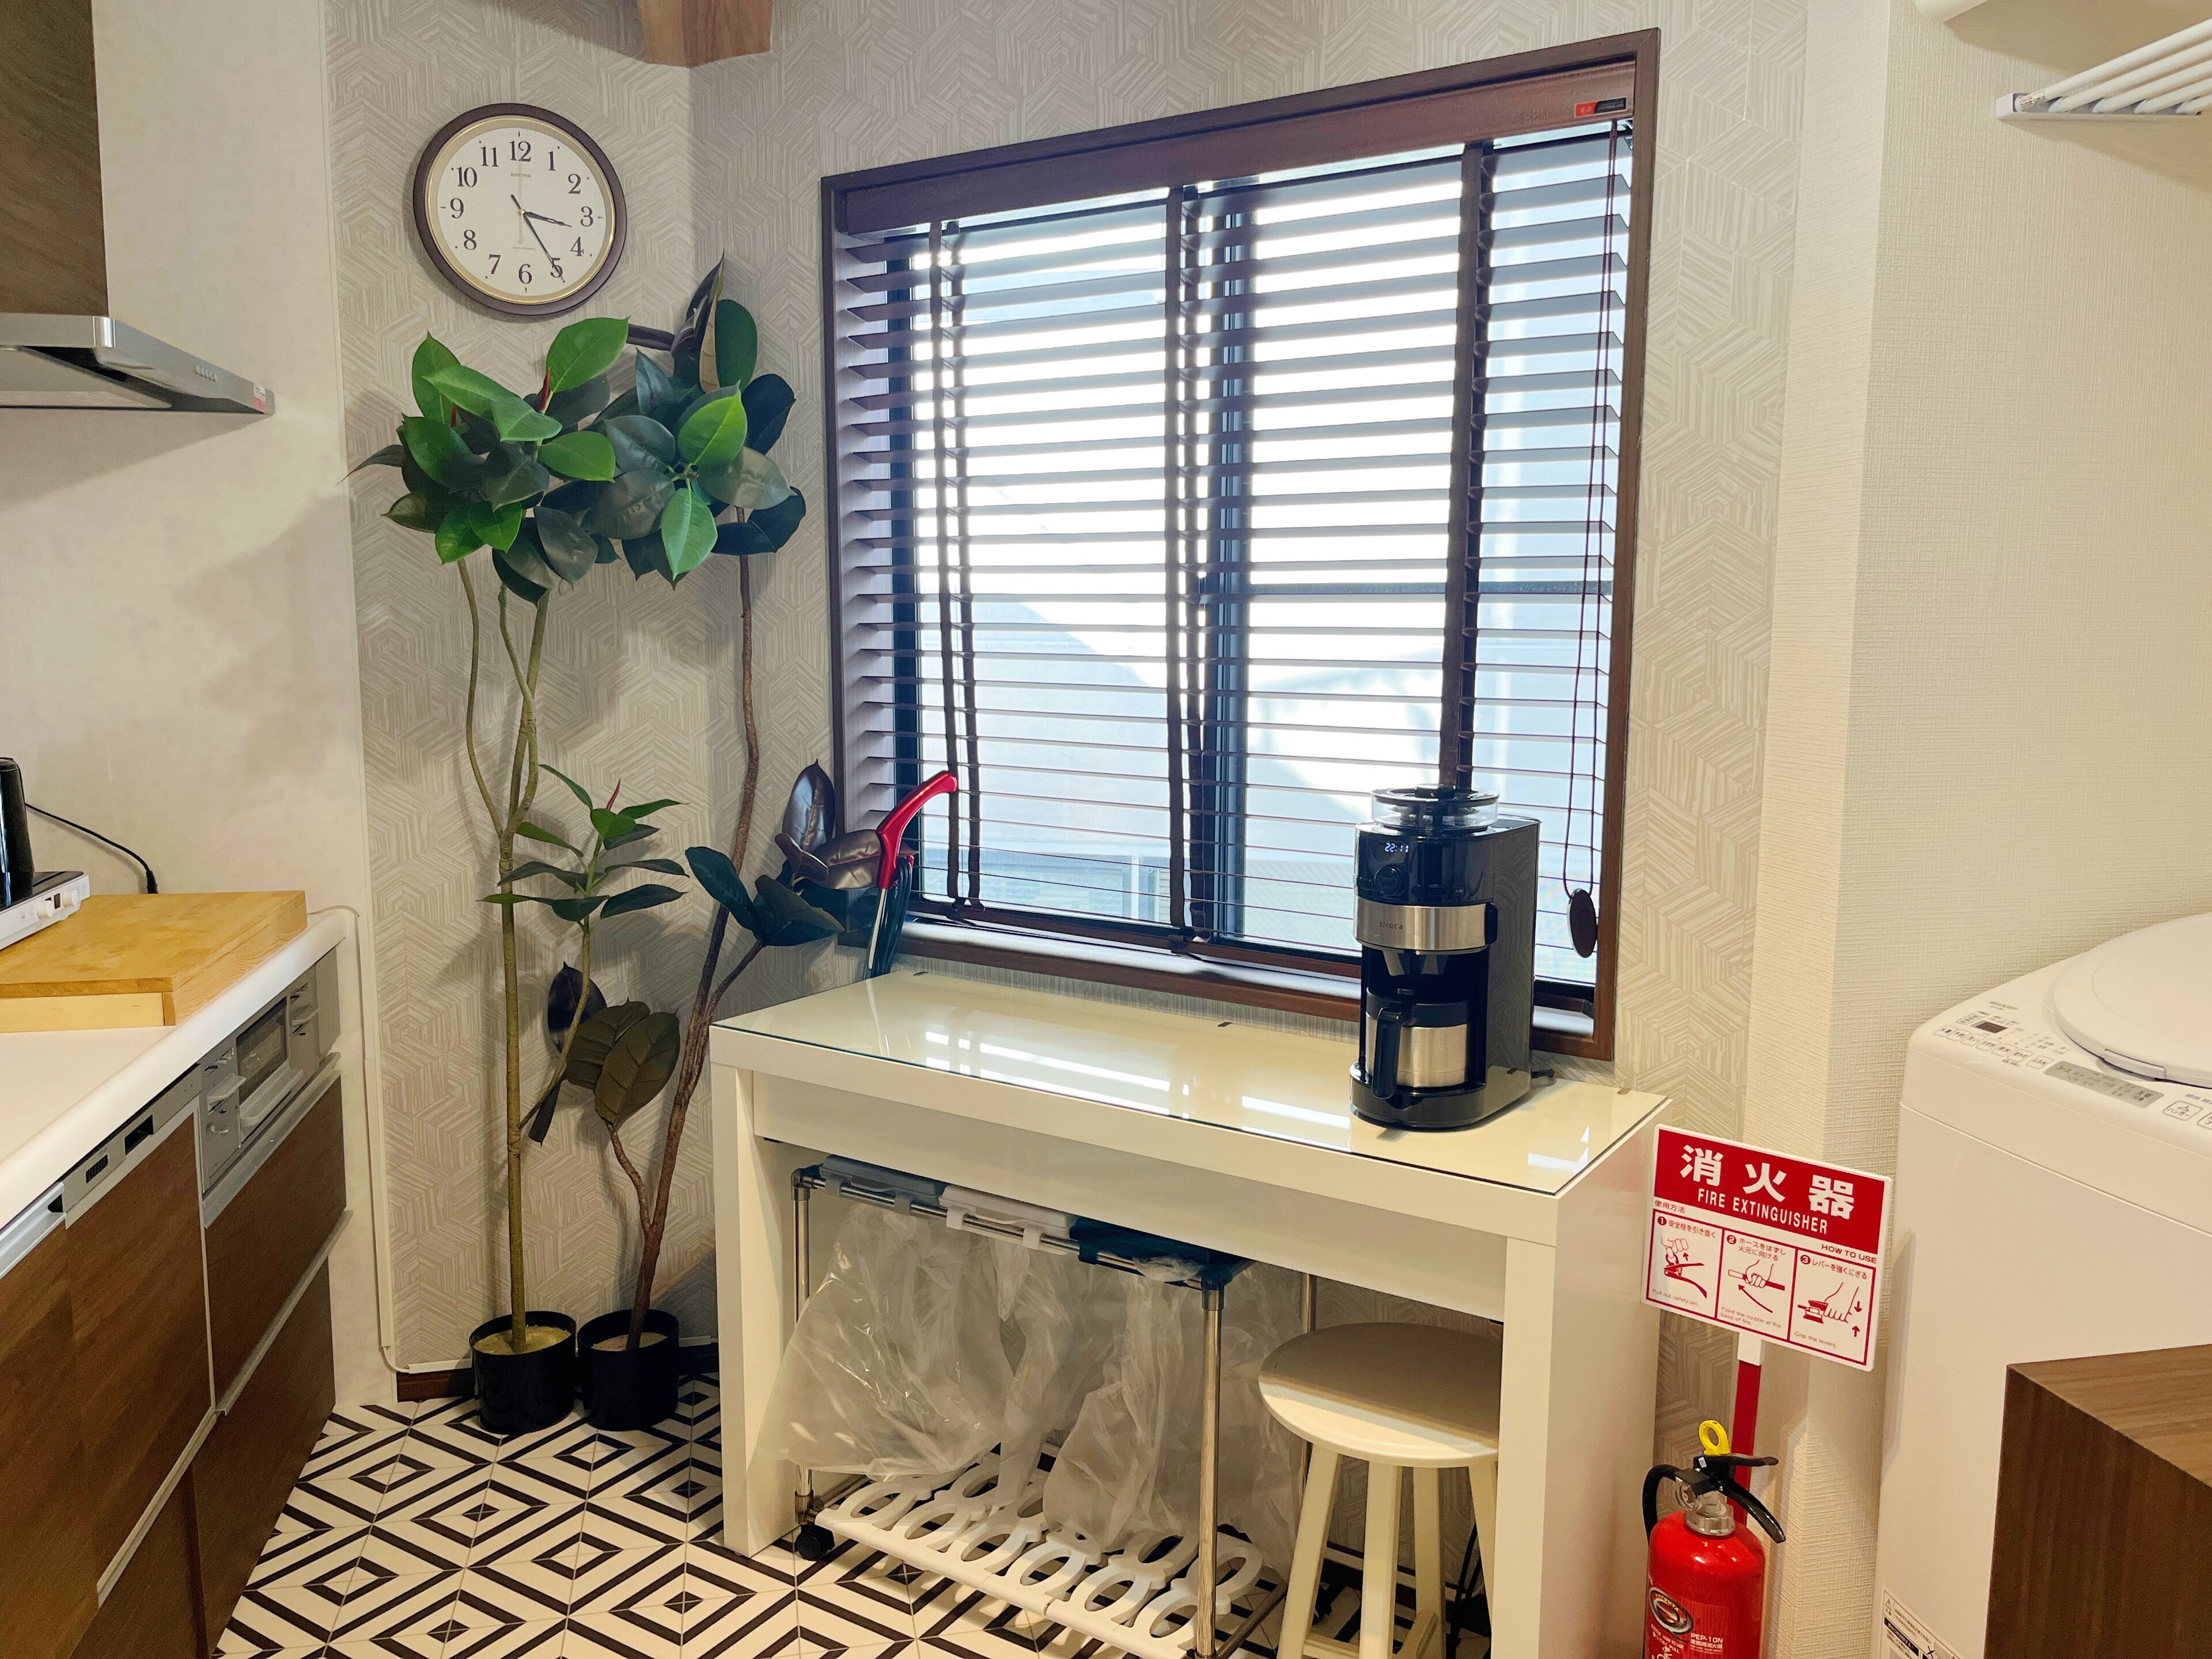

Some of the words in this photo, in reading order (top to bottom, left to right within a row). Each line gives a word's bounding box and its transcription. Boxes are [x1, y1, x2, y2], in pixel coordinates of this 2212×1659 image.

[480, 146, 499, 168] 11
[509, 141, 532, 162] 12
[548, 150, 557, 171] 1
[457, 166, 478, 187] 10
[568, 173, 581, 195] 2
[450, 198, 464, 219] 9
[580, 206, 594, 227] 3
[463, 229, 477, 251] 8
[570, 237, 584, 257] 4
[488, 254, 501, 275] 7
[518, 263, 532, 285] 6
[550, 257, 563, 278] 5
[1384, 842, 1409, 853] 22:11
[1379, 921, 1403, 930] siroca
[1679, 1144, 1855, 1220] 消火器
[1654, 1200, 1685, 1214] 使用方法
[1697, 1188, 1726, 1208] FIRE
[1733, 1197, 1828, 1234] EXTINGUISHER
[1668, 1219, 1716, 1238] 安全栓を引き抜く
[1738, 1245, 1778, 1262] 火元に向ける
[1739, 1238, 1787, 1255] ホースをはずし
[1821, 1244, 1843, 1255] HOW
[1844, 1250, 1856, 1258] TO
[1858, 1253, 1878, 1264] USE
[1812, 1259, 1867, 1280] レバーを強くにぎる
[1673, 1294, 1688, 1304] safety
[1721, 1306, 1735, 1315] Point
[1747, 1313, 1764, 1323] nozzle
[1794, 1331, 1806, 1339] Grip
[1691, 1633, 1724, 1643] PEP-10N
